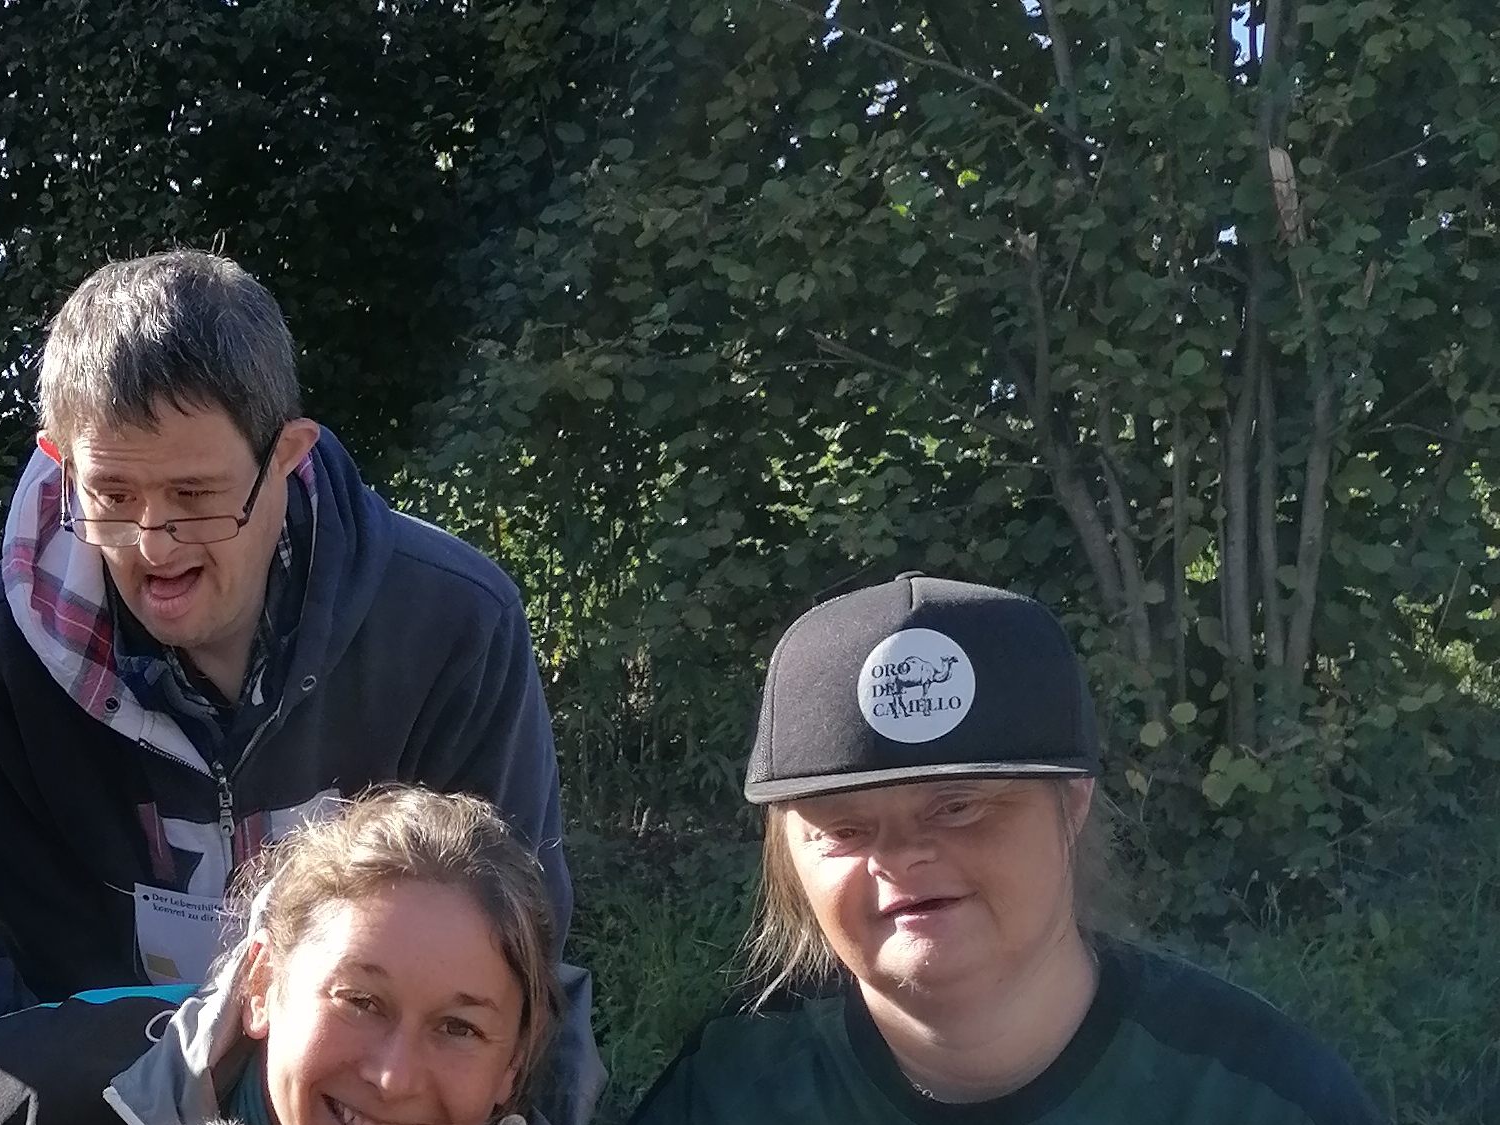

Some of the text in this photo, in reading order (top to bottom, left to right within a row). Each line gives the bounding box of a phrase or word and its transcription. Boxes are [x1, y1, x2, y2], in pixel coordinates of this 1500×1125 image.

[871, 662, 911, 679] ORO
[873, 696, 962, 717] CAMELLO
[152, 893, 168, 903] Der
[201, 914, 214, 922] dir
